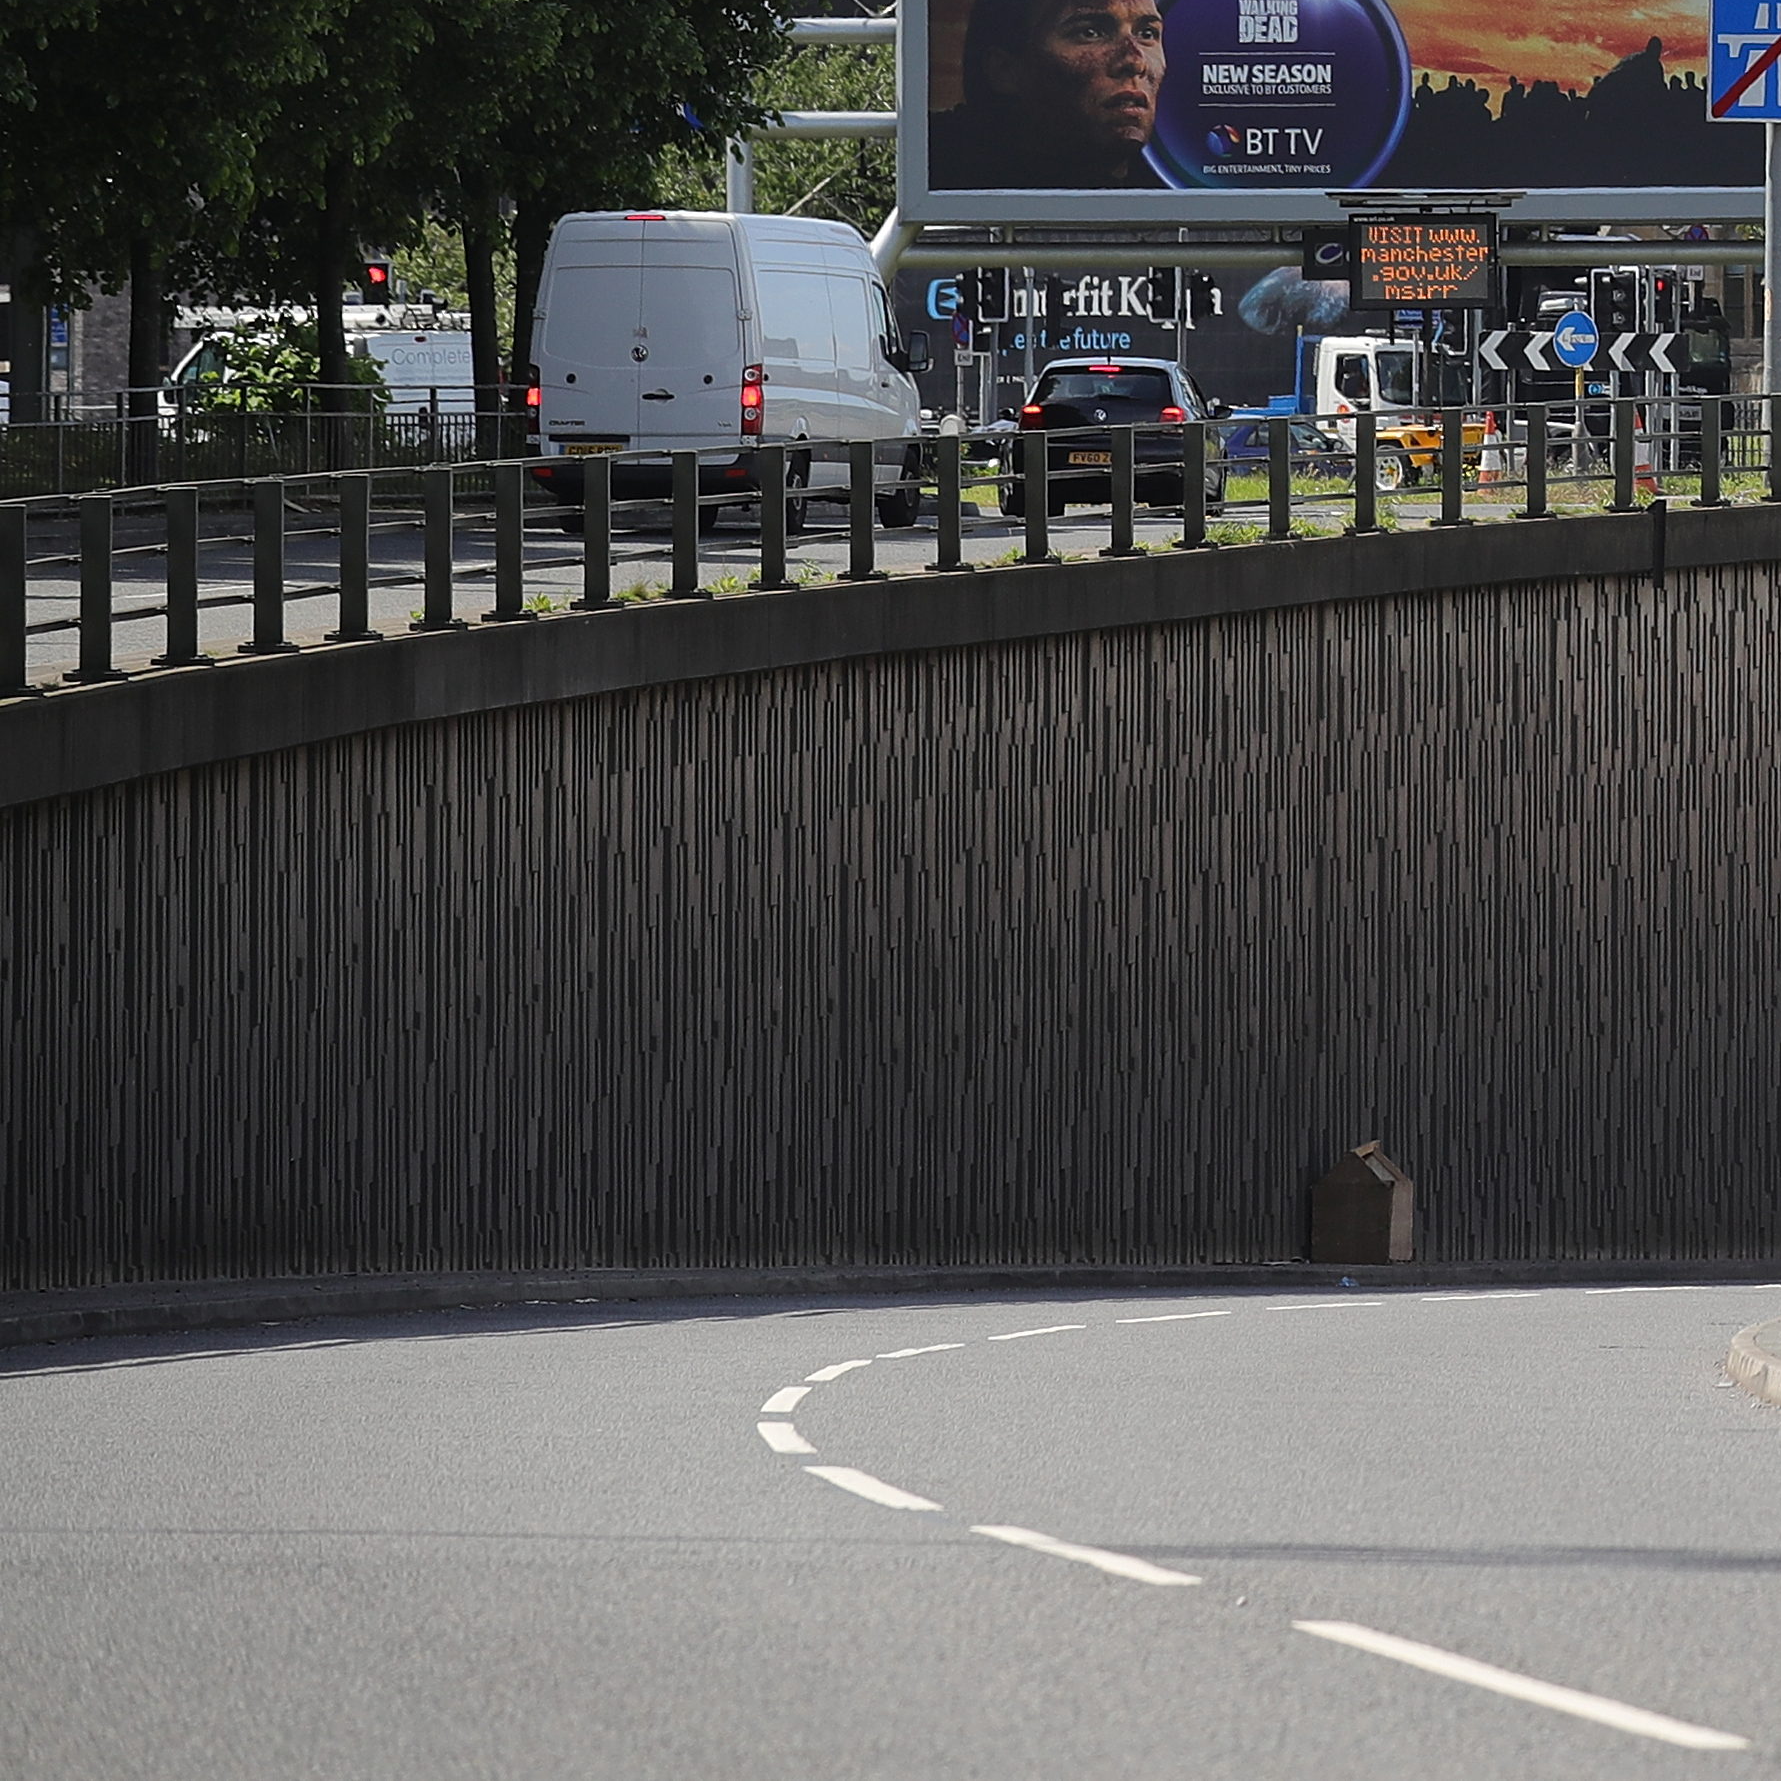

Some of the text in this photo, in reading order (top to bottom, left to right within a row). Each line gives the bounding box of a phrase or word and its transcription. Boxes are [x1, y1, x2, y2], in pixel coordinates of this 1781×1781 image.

[1239, 0, 1298, 16] WALKING
[1239, 15, 1299, 44] DEAD
[1203, 64, 1332, 84] NEW SEASON
[1203, 84, 1332, 95] EXCLUSIVE TO BT CUSTOMERS
[1246, 128, 1323, 155] BT TV
[1303, 164, 1332, 174] PRICES
[1368, 226, 1481, 244] VISIT www.
[1361, 245, 1489, 263] manchester
[1372, 265, 1478, 281] .gov.uk/
[1384, 283, 1458, 299] msirr
[1073, 326, 1131, 350] future
[391, 348, 471, 366] Complete
